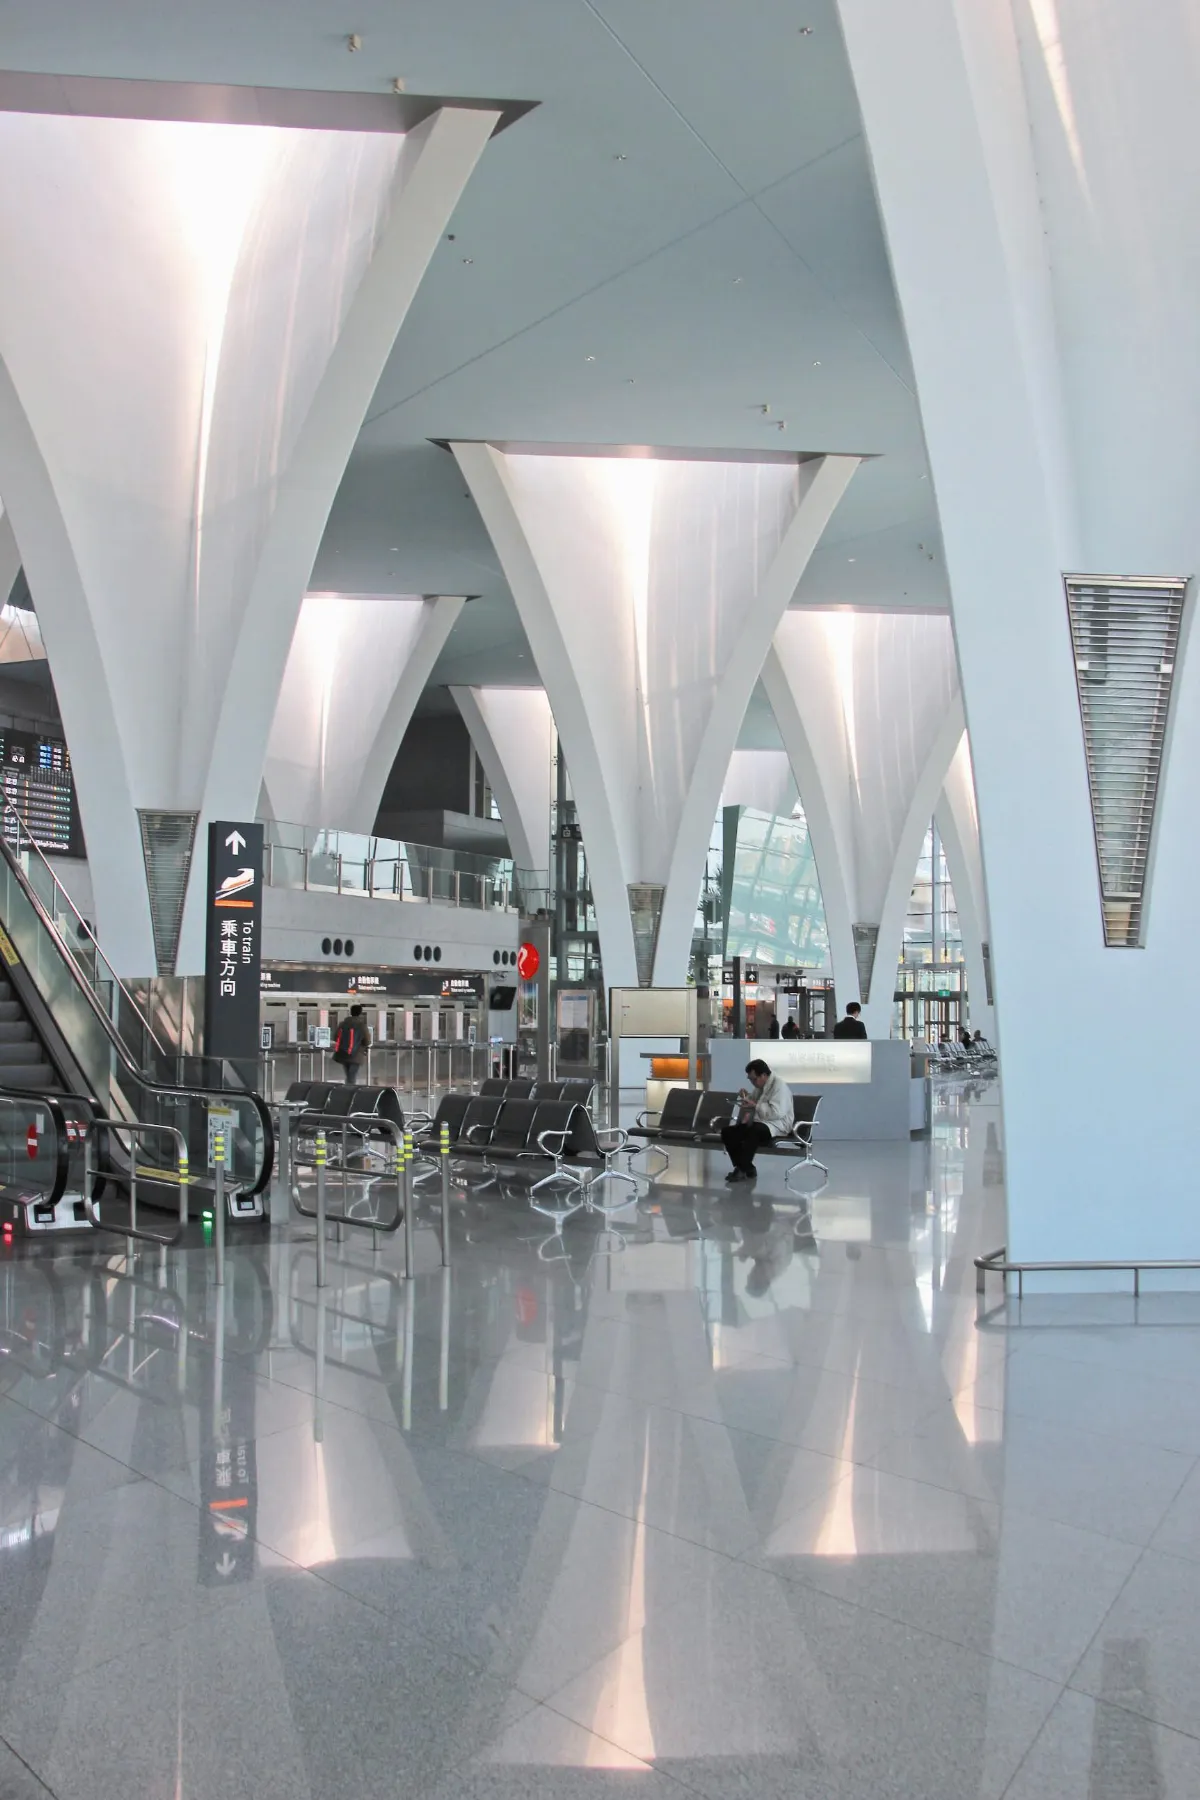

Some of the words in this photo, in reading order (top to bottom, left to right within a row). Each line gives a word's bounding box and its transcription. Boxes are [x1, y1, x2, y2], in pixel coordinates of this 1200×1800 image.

[242, 920, 254, 935] To
[219, 919, 238, 997] 乘車方向
[242, 936, 254, 964] train
